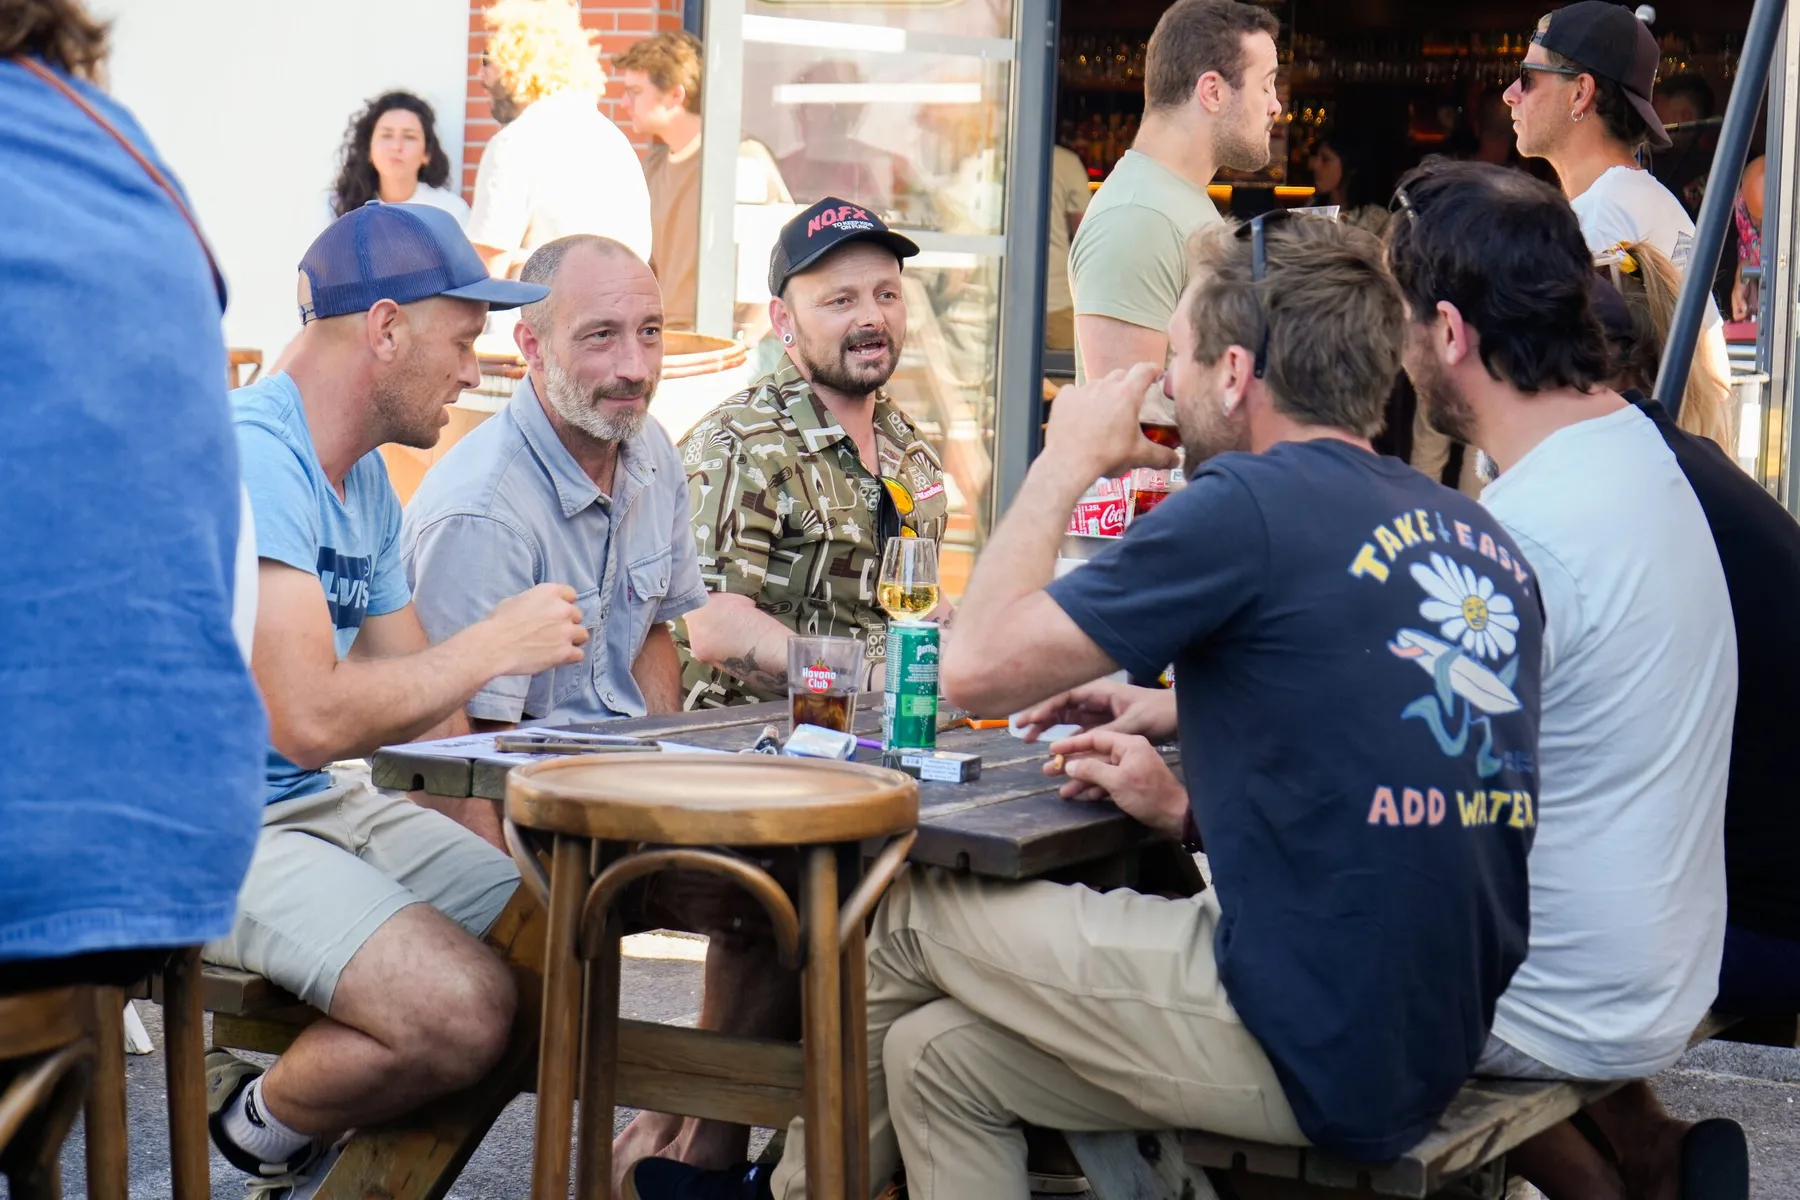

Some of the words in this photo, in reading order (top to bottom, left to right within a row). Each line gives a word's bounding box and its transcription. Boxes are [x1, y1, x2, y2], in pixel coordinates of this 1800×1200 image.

[1349, 509, 1436, 583] TAKE
[320, 570, 369, 609] LVIS
[802, 667, 836, 679] Havana
[808, 679, 828, 689] Club
[1367, 785, 1446, 826] ADD
